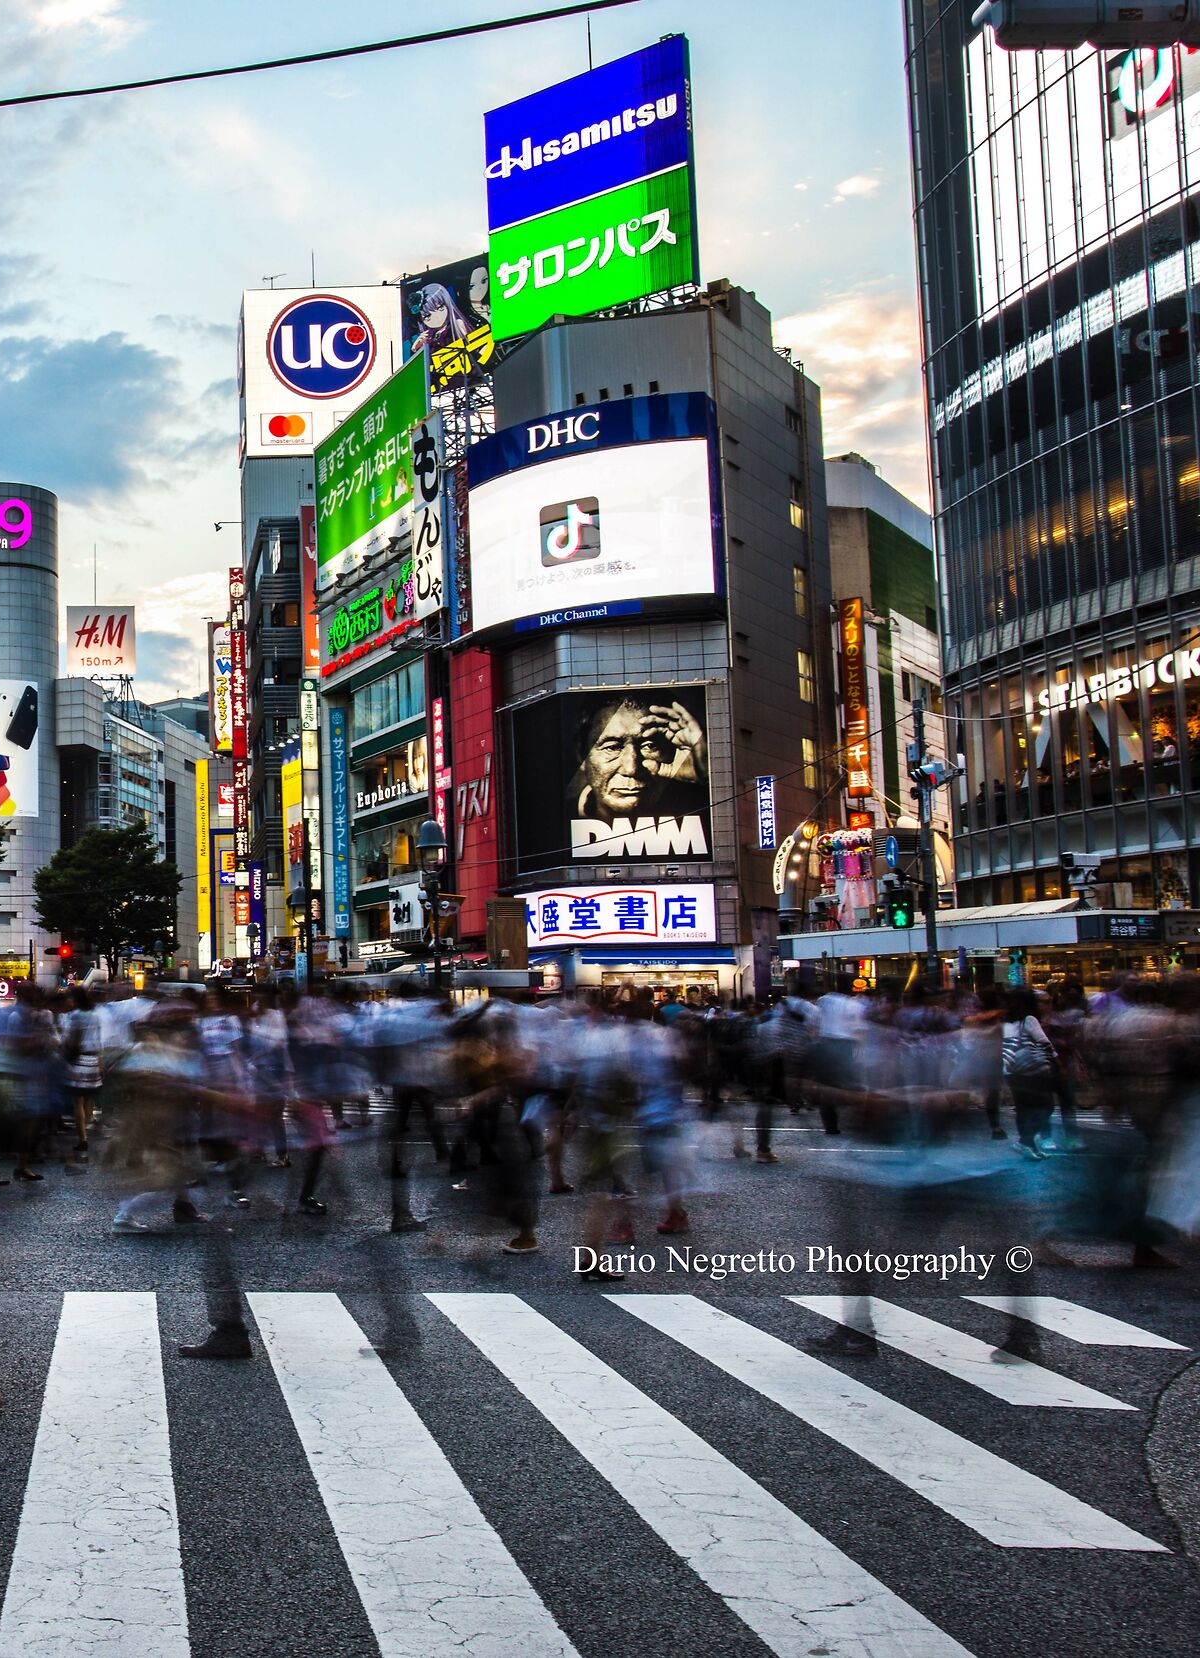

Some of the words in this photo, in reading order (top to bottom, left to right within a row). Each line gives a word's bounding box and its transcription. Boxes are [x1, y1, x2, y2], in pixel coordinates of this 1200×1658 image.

[483, 93, 677, 179] Hisamitsu
[496, 207, 677, 299] サロンパス
[527, 411, 600, 453] DHC
[412, 423, 443, 605] もんじゃ
[75, 614, 128, 649] H&M
[539, 612, 563, 626] DHC
[564, 605, 608, 621] Channel
[80, 655, 112, 667] 150m
[847, 719, 869, 788] 三千里
[332, 736, 346, 852] サマーフルーツギフト
[356, 777, 408, 809] Euphoria
[570, 815, 708, 858] DMM
[253, 868, 262, 900] MIZUHO
[1110, 925, 1138, 937] 渋谷駅
